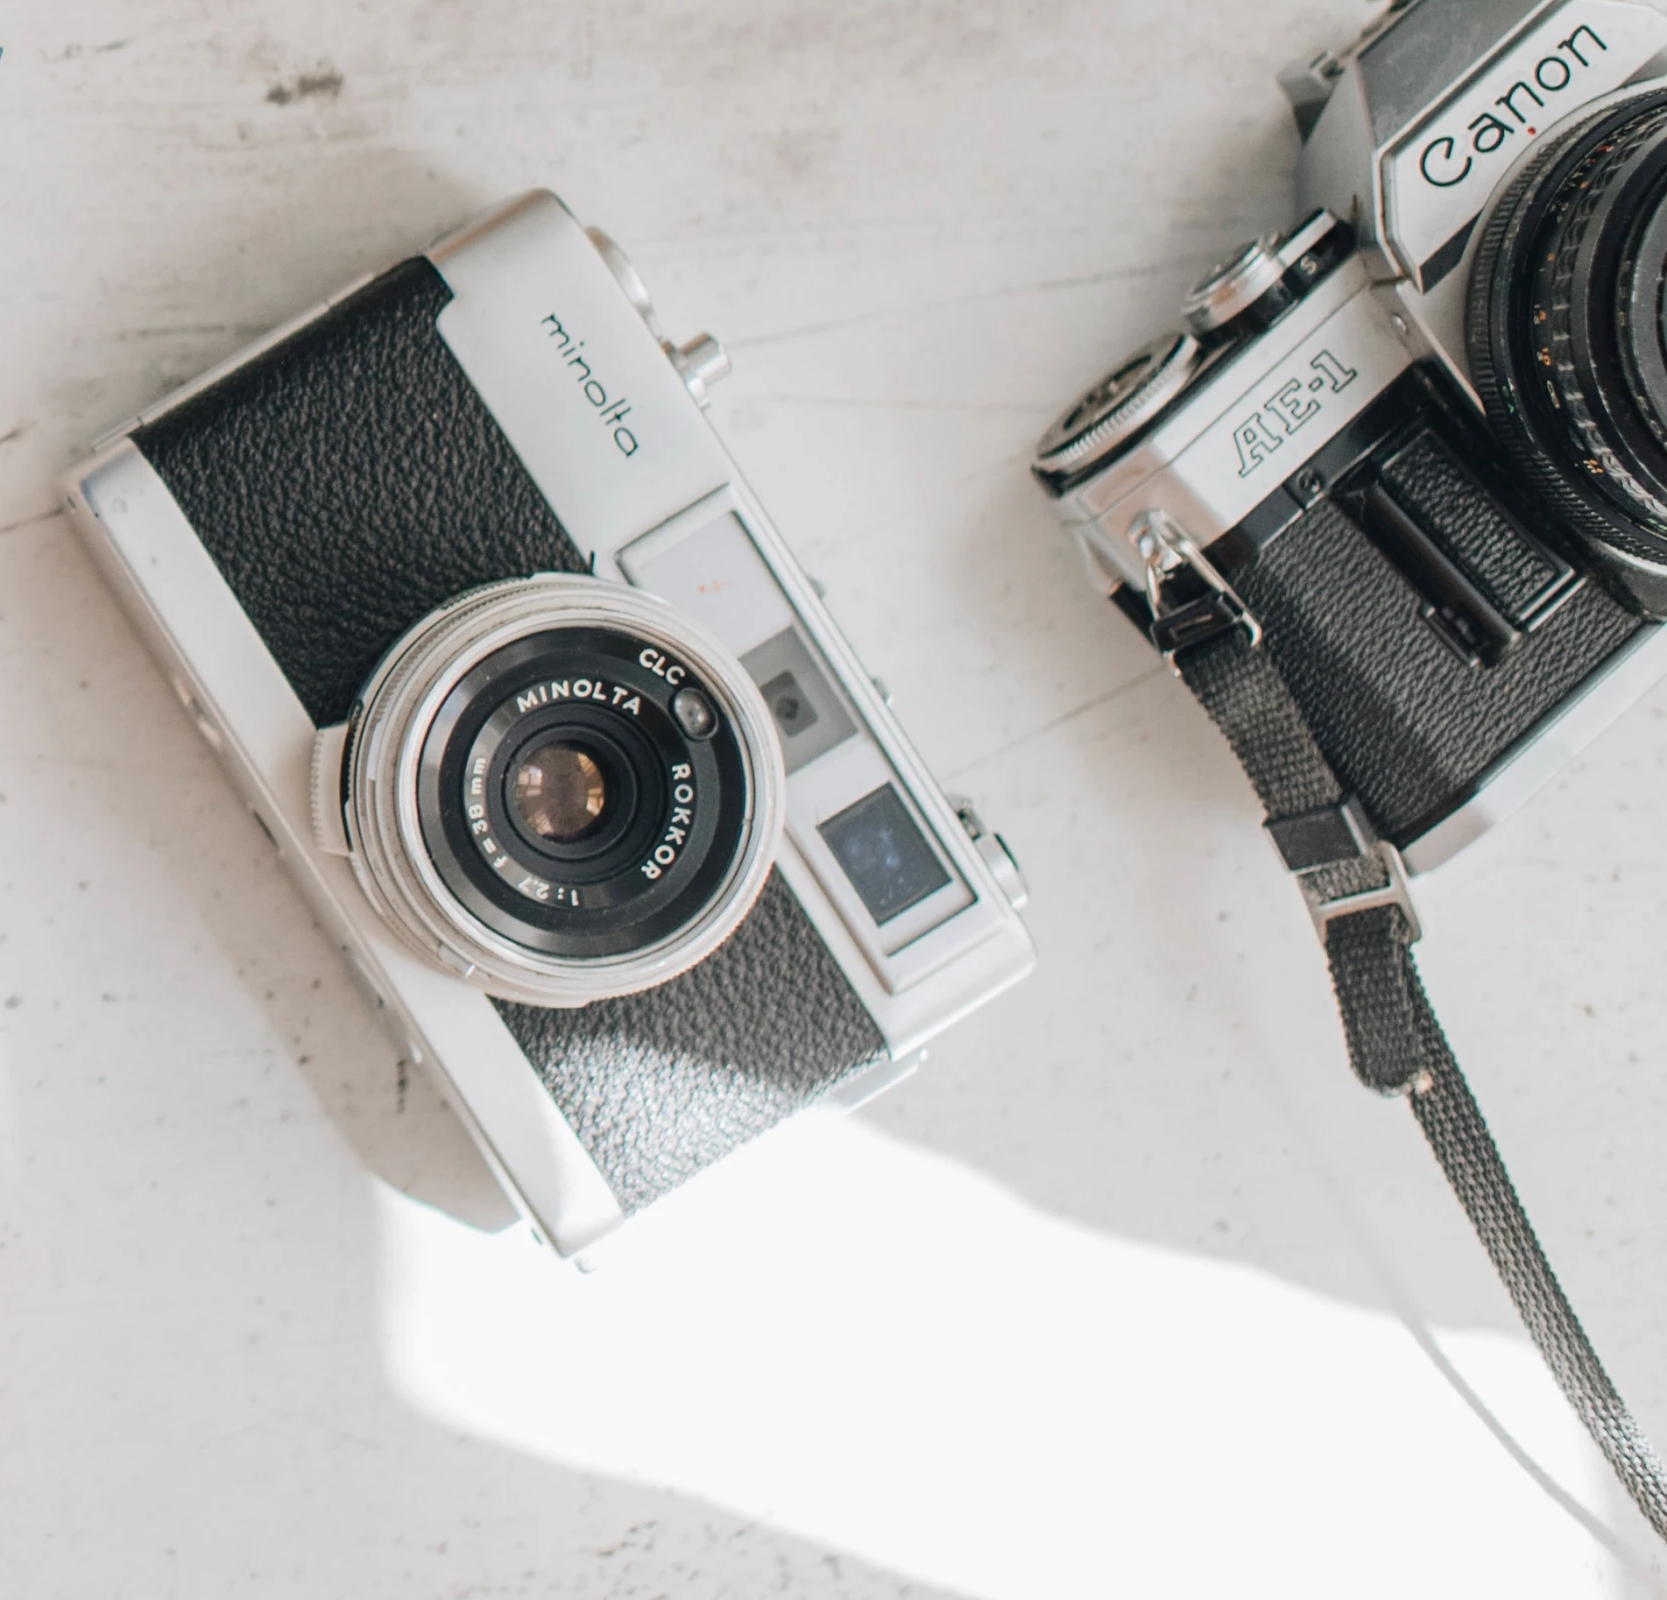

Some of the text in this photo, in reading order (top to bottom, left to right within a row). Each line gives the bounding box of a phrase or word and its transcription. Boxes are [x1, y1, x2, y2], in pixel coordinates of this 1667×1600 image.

[1419, 21, 1608, 189] Canon
[541, 312, 639, 458] minolta
[1233, 349, 1359, 478] AE-1
[639, 648, 685, 685] CLC
[517, 679, 642, 715] MINOLTA
[640, 762, 694, 880] ROKKOR
